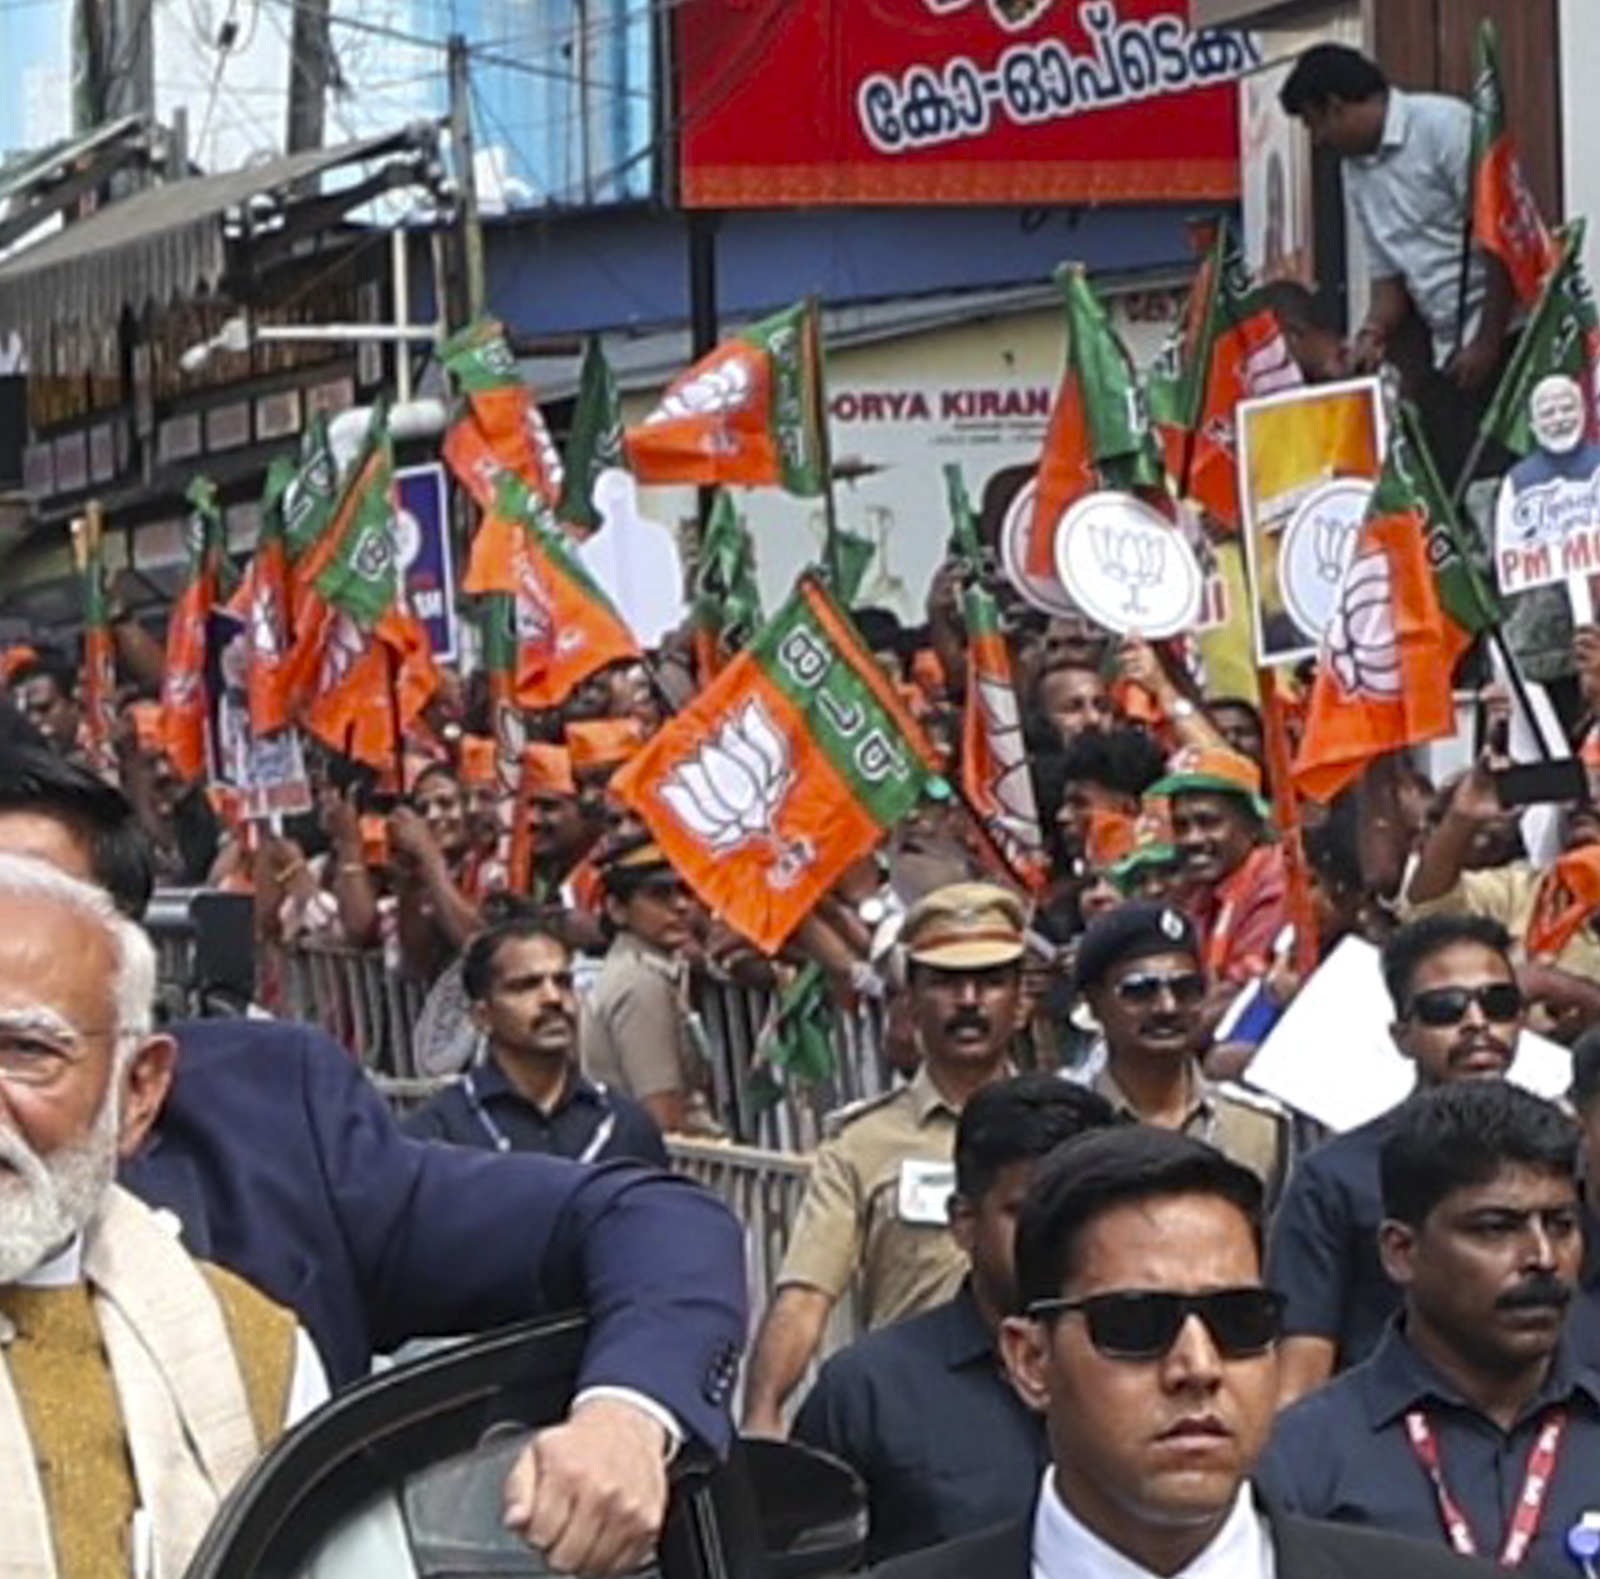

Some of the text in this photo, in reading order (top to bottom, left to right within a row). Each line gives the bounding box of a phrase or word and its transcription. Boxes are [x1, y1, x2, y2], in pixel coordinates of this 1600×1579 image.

[828, 386, 1050, 422] ORYA KIRAN
[1500, 548, 1552, 590] PM
[778, 623, 911, 784] BJP
